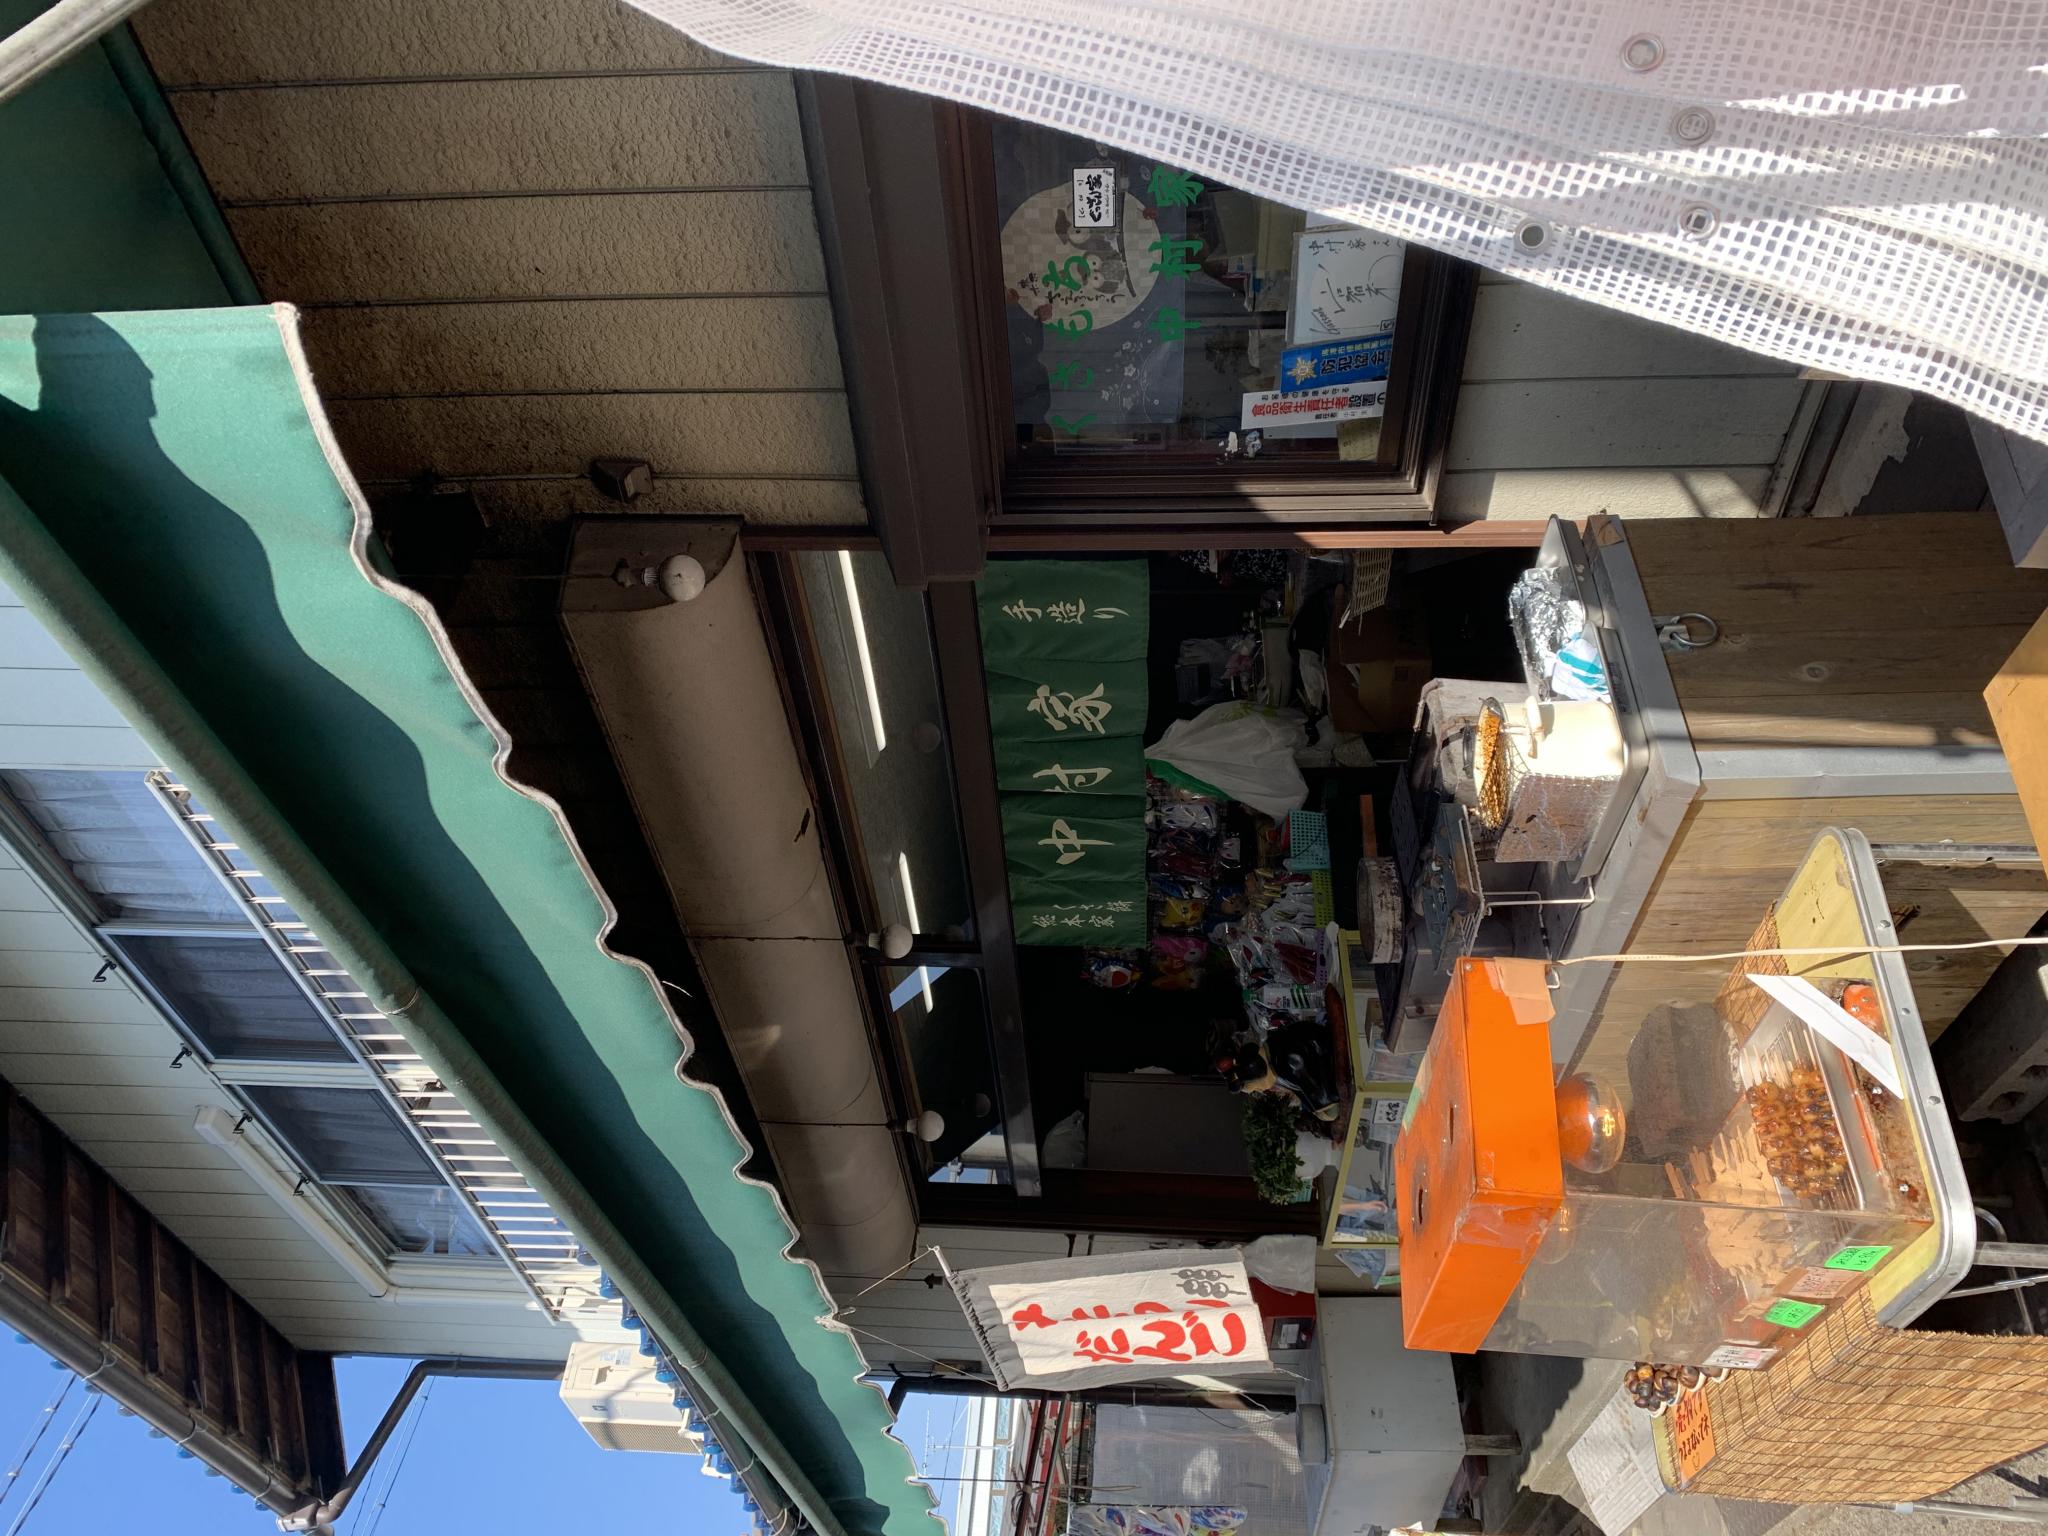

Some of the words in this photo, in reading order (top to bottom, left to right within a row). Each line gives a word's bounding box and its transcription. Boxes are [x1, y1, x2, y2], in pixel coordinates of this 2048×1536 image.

[1148, 163, 1206, 341] 中村家
[1042, 255, 1098, 435] くさもち
[1320, 350, 1386, 375] 防犯協会
[1001, 597, 1130, 626] 手造り
[1026, 682, 1115, 867] 中村家
[1031, 914, 1115, 930] 総本家
[1052, 900, 1135, 914] くさ餅
[1071, 1311, 1247, 1364] だんご
